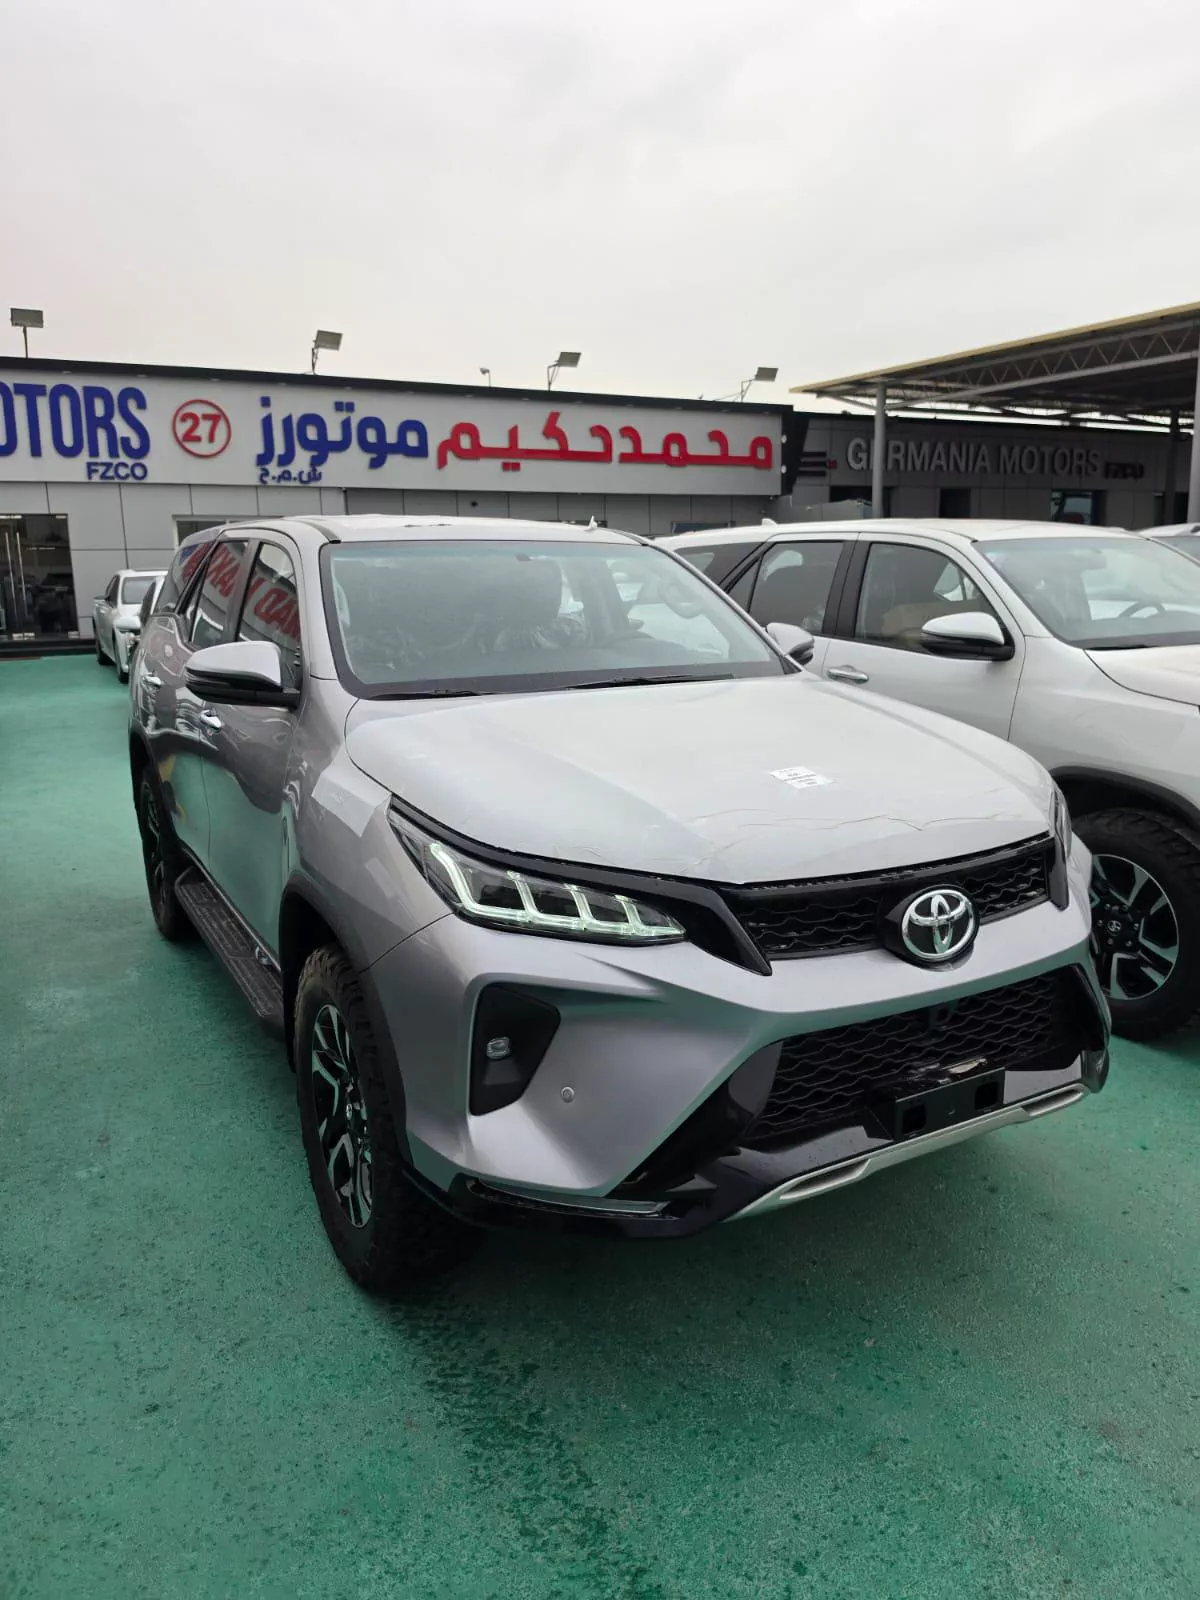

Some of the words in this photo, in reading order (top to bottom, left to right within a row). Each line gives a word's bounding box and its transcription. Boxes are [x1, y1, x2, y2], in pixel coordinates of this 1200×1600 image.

[180, 411, 222, 444] 27
[256, 395, 429, 470] موتورز
[436, 411, 613, 472] حكيم
[618, 425, 773, 470] محمد
[999, 444, 1101, 477] MOTORS
[86, 461, 149, 481] FZCO
